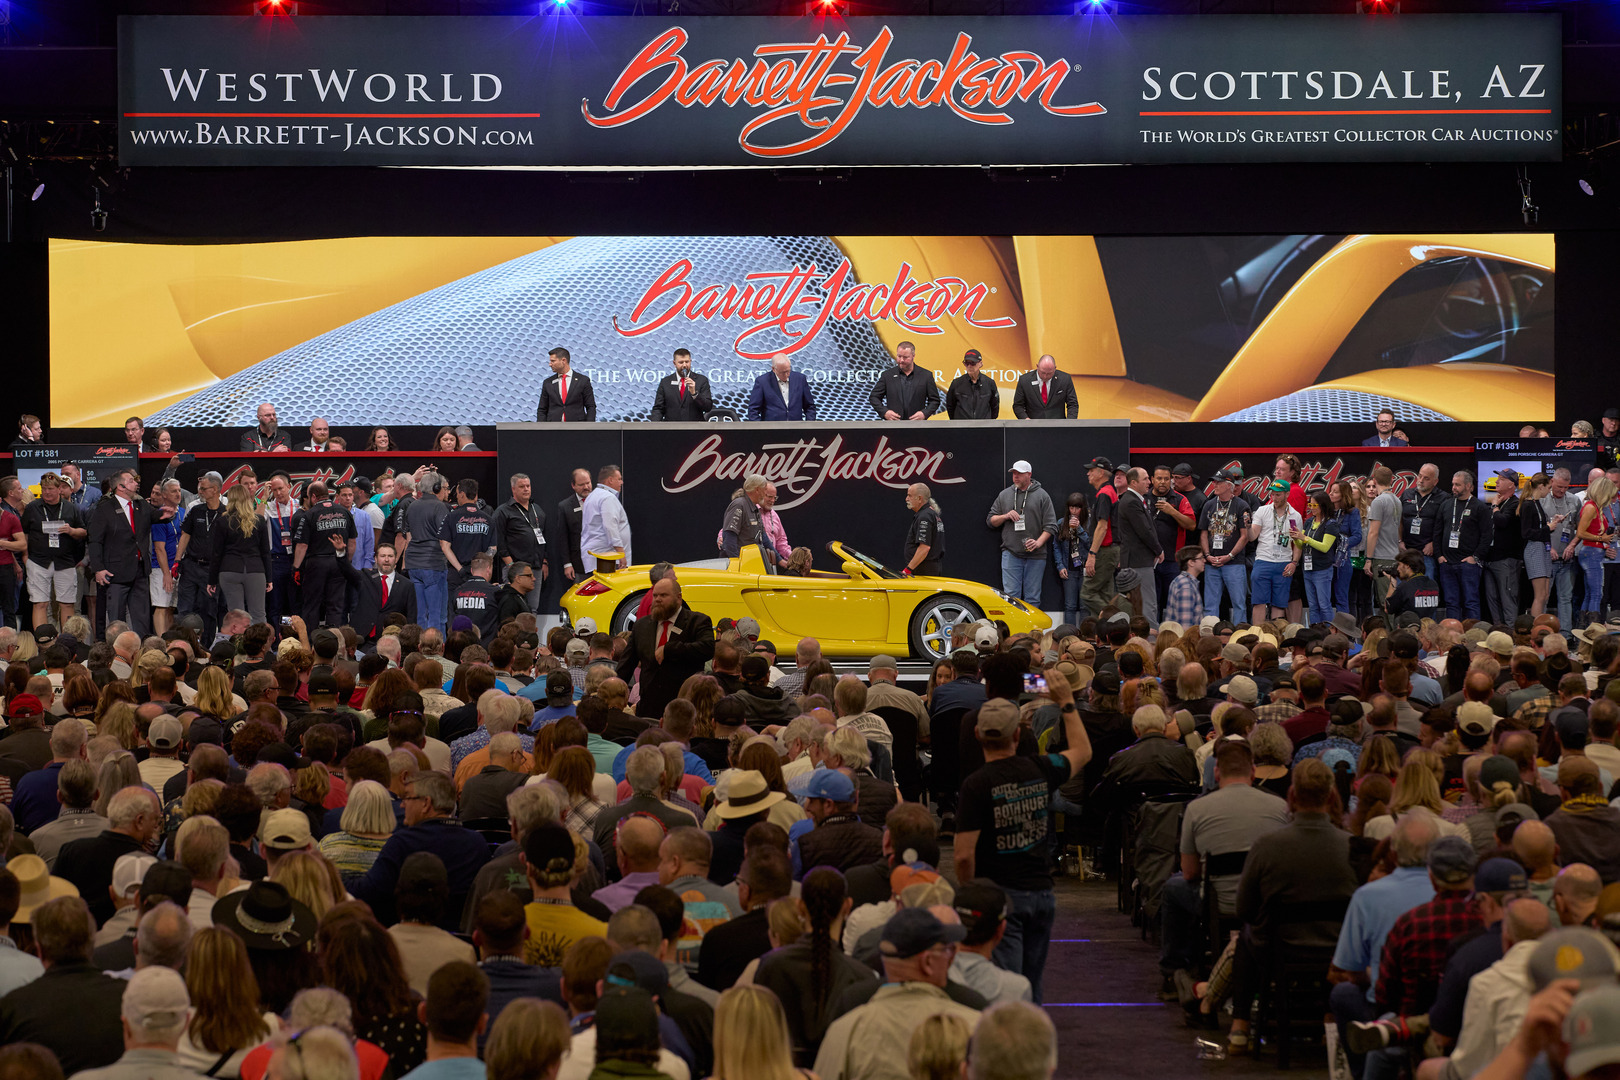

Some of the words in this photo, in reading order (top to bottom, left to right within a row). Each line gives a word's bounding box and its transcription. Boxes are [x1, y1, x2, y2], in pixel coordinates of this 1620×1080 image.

[581, 25, 1107, 158] Barrett-Jackson
[1479, 64, 1546, 99] AZ
[613, 257, 1017, 361] Barrett-Jackson
[15, 449, 33, 458] LOT
[35, 449, 59, 458] #1381
[1476, 442, 1494, 450] LOT
[1495, 442, 1519, 450] #1381
[660, 432, 966, 511] Barrett-Jackson
[457, 523, 489, 534] SECURITY
[456, 597, 486, 609] MEDIA
